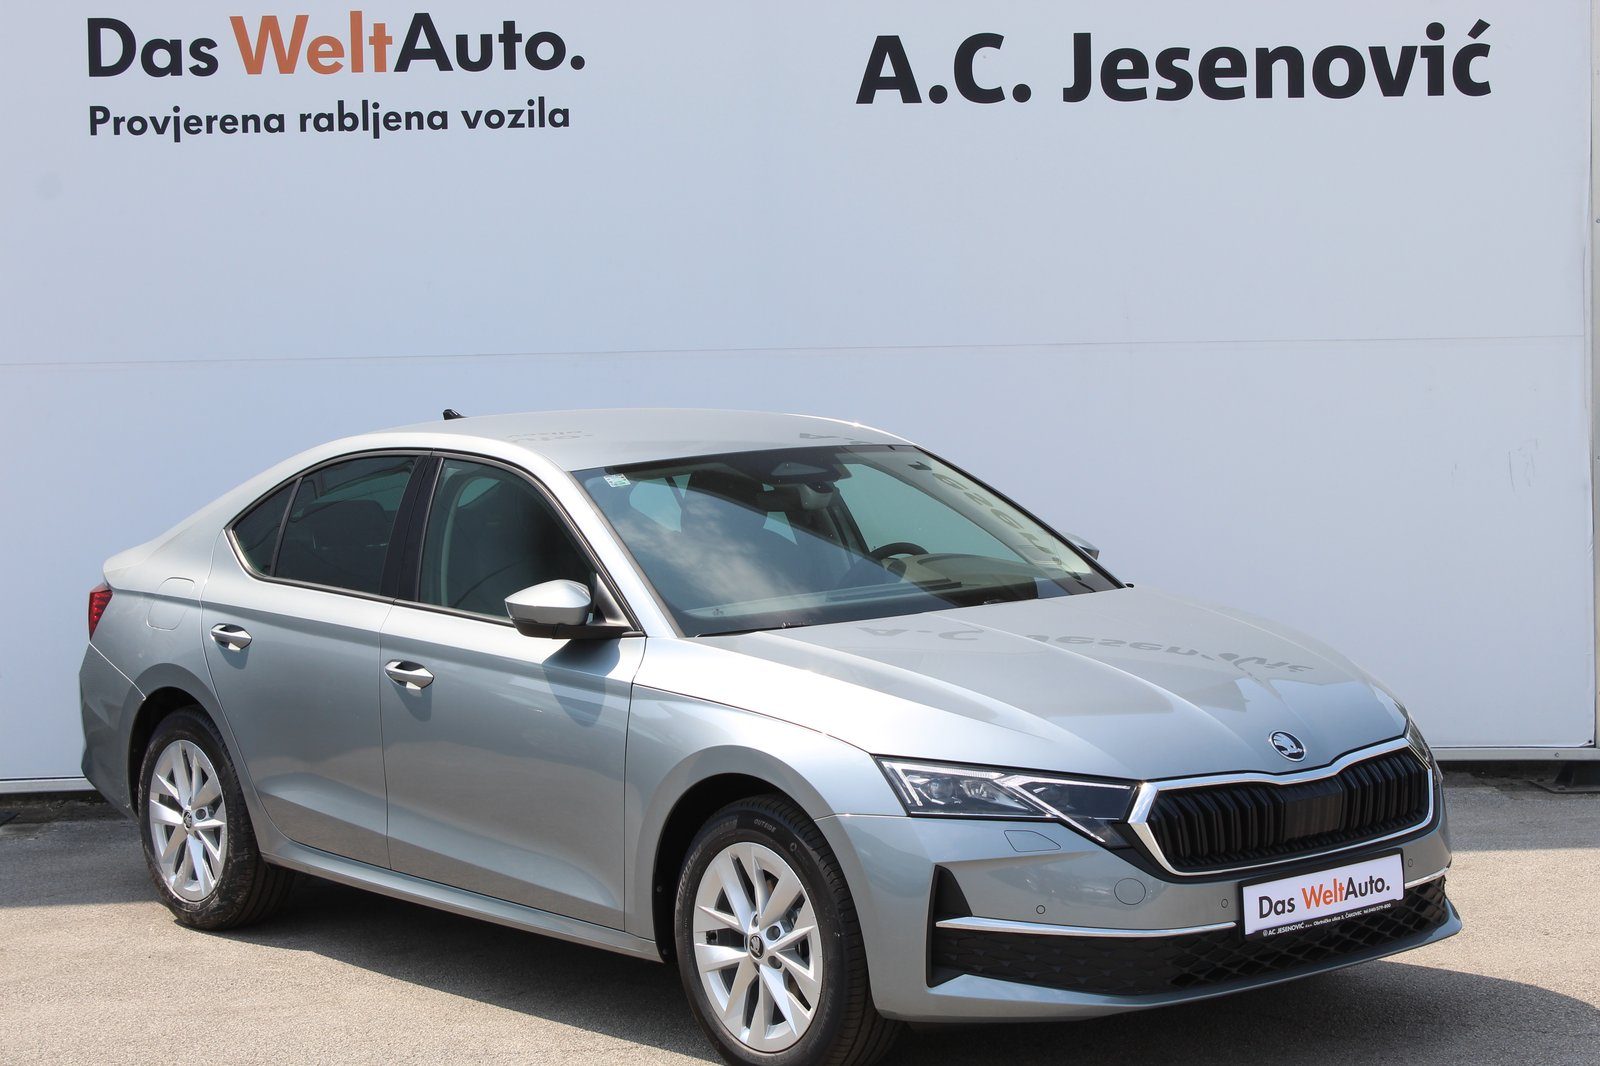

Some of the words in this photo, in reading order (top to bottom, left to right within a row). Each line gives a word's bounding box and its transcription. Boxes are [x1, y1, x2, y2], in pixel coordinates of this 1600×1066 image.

[87, 17, 219, 78] Das
[231, 11, 586, 75] WeltAuto.
[855, 32, 1032, 105] A.C.
[1062, 18, 1492, 103] Jesenović
[89, 105, 285, 143] Provjerena
[299, 99, 448, 140] rabljena
[460, 95, 570, 130] vozila
[1258, 895, 1296, 919] Das
[1302, 876, 1390, 909] WeltAuto.
[1277, 921, 1304, 934] JESENOVIĆ
